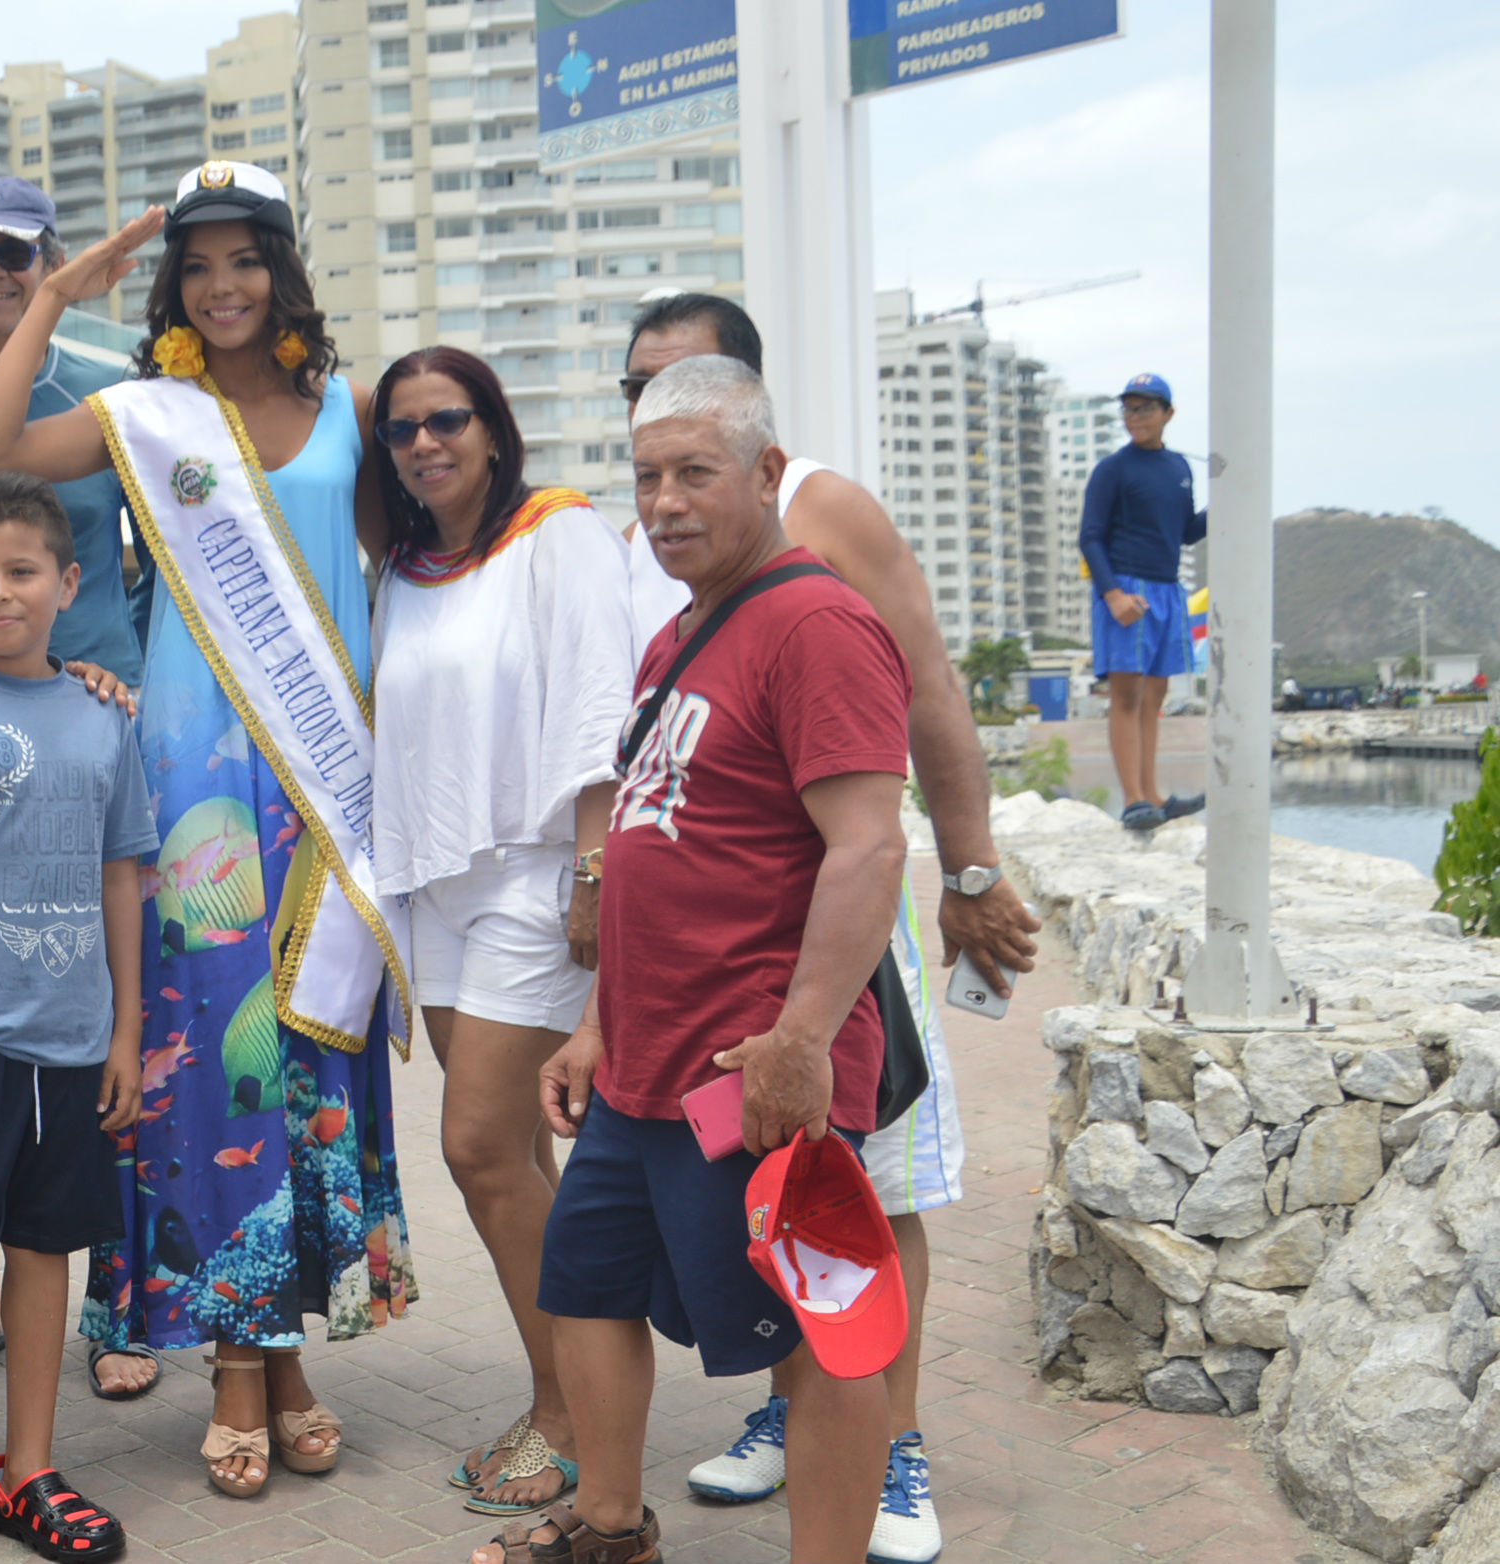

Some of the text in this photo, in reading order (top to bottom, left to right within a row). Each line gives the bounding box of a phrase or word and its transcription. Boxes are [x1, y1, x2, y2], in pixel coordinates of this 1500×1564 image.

[897, 2, 1045, 53] PARQUEADEROS
[618, 35, 738, 83] AQUI ESTAMOS
[619, 61, 737, 105] EN LA MARINA
[898, 41, 989, 78] PRIVADOS
[197, 518, 293, 652] CAPITANA
[265, 648, 358, 781] NACIONAL
